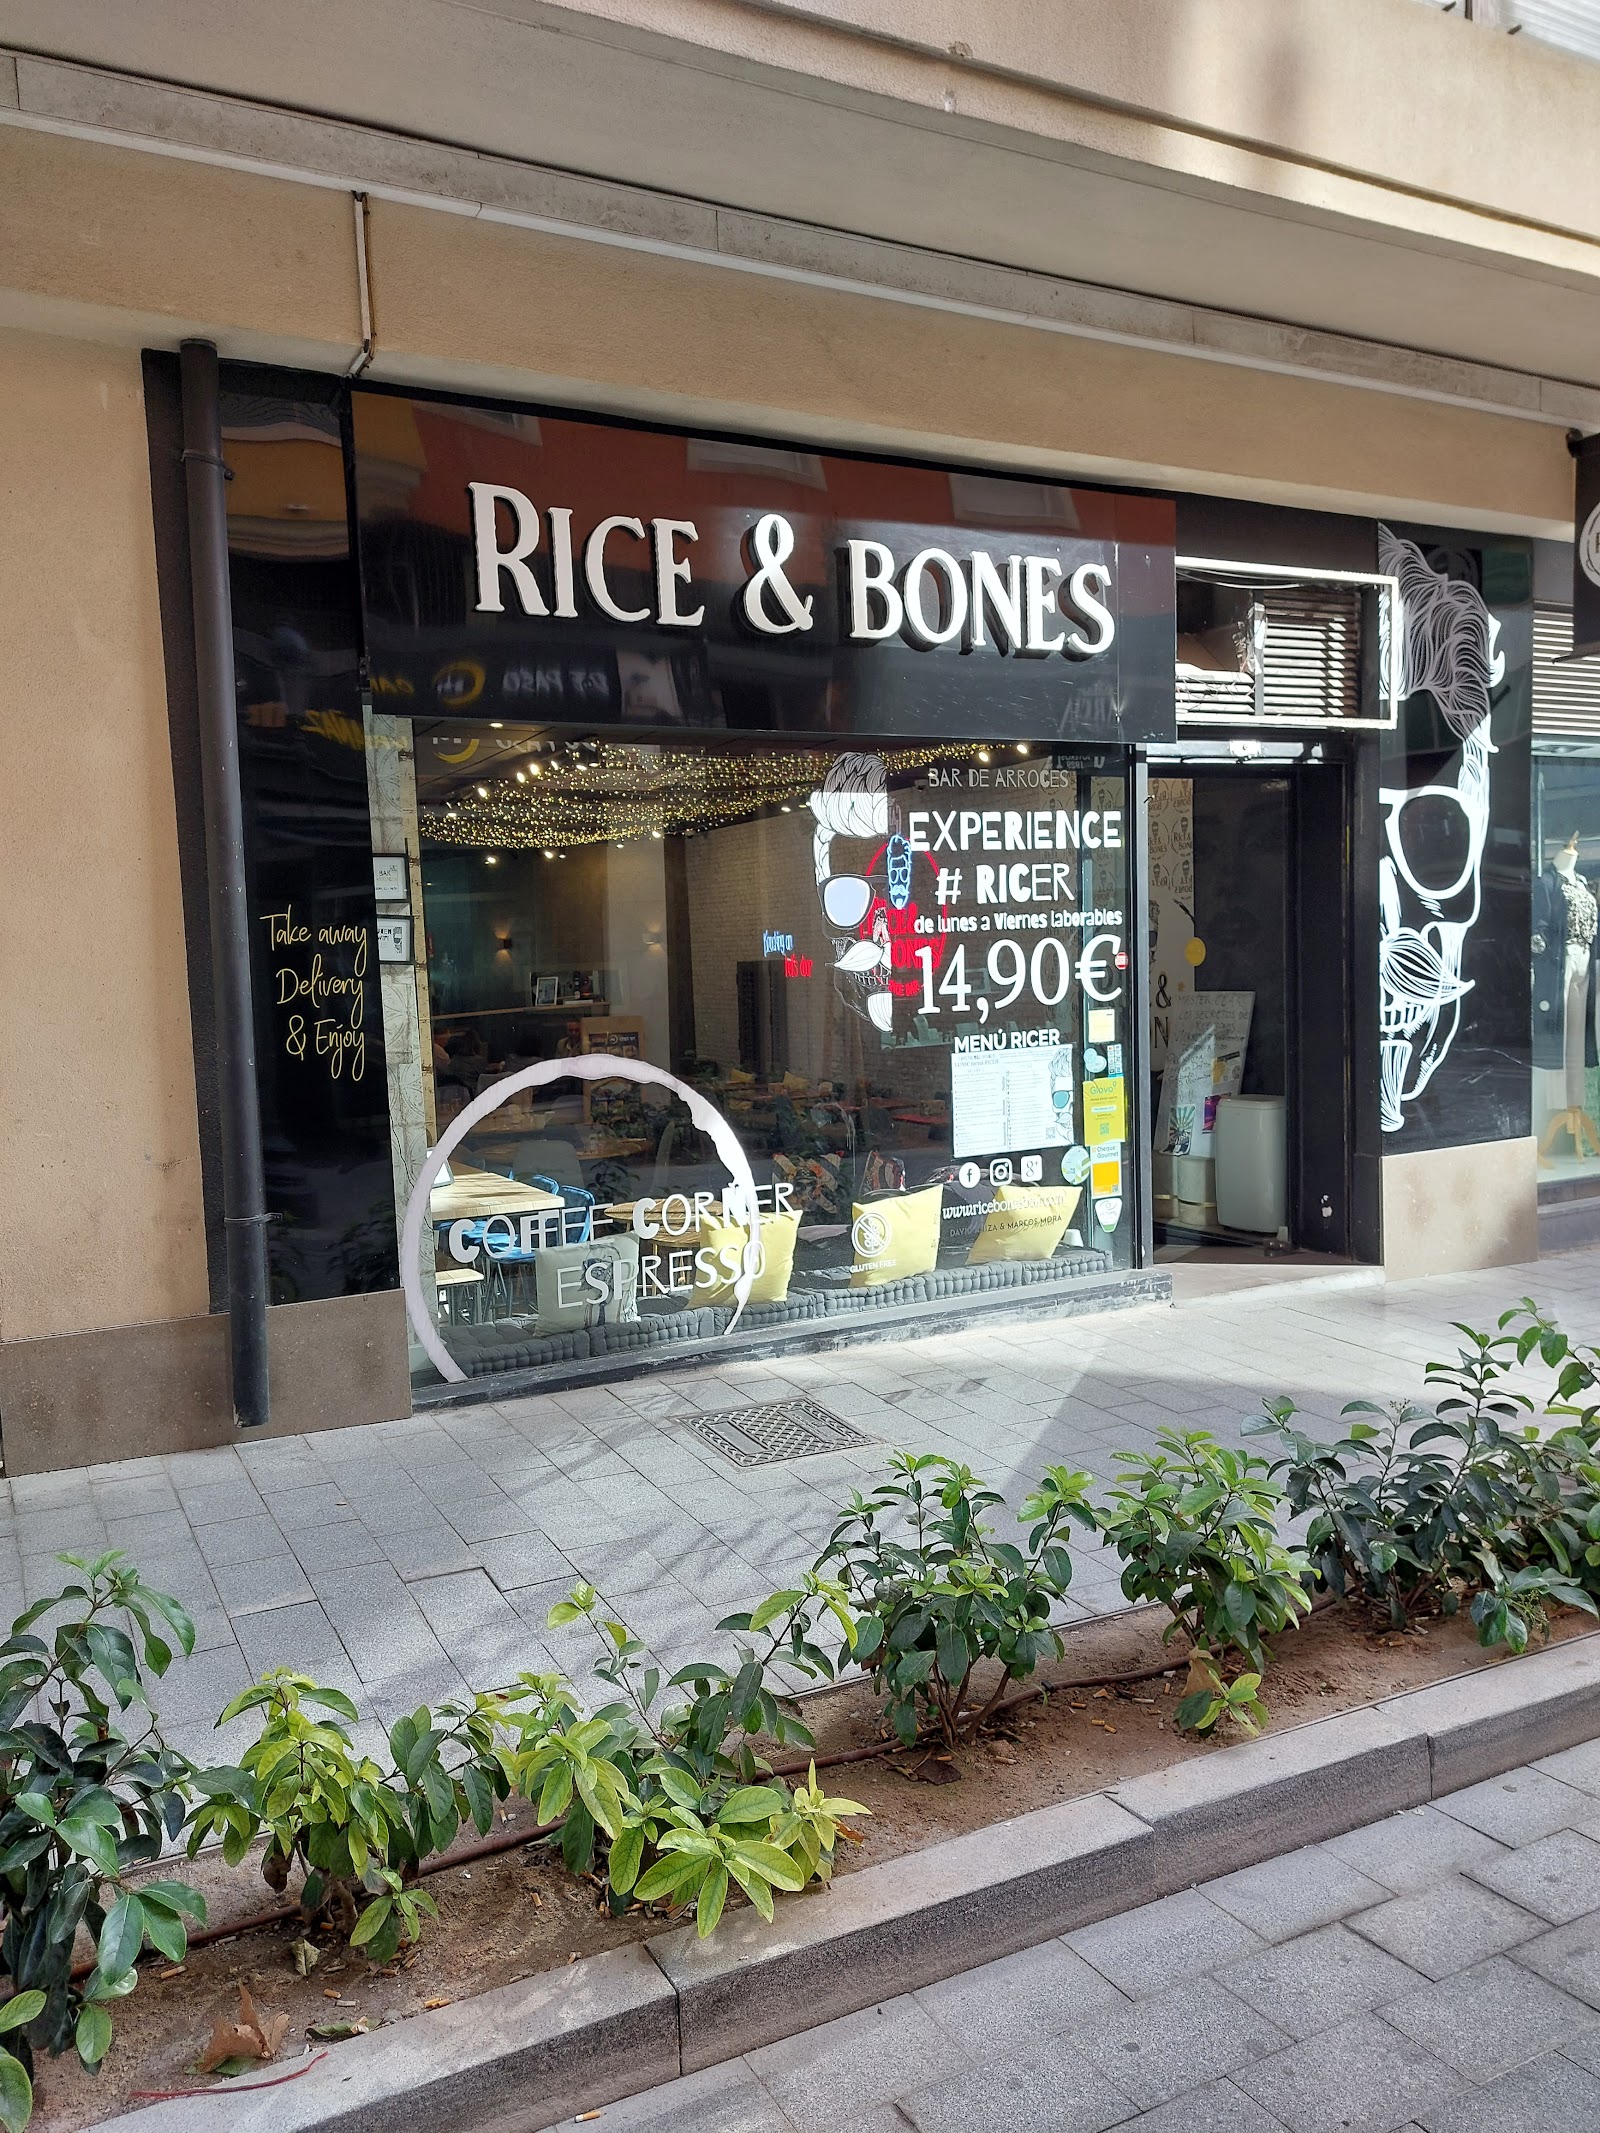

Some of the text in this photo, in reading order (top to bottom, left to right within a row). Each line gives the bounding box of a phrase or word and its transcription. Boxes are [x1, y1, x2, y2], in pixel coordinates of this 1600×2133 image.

[468, 481, 1117, 657] RICE & BONES
[928, 768, 1069, 788] BAR DE ARROCES
[908, 809, 1122, 852] EXPERIENCE
[935, 863, 1076, 906] # RICER
[259, 904, 367, 977] Take away
[914, 908, 1123, 934] de lunes a Viernes laborables
[276, 953, 363, 1029] Delivery
[914, 933, 1123, 1024] 14,90€
[286, 1014, 365, 1082] & Enjoy
[954, 1028, 1060, 1054] MENÚ RICER
[1096, 1145, 1116, 1153] Cheque
[1096, 1150, 1119, 1159] Gourmet
[448, 1182, 794, 1263] COFFEE CORNER
[557, 1240, 766, 1309] ESPRESSO
[850, 1259, 897, 1273] GLUTEN FREE
